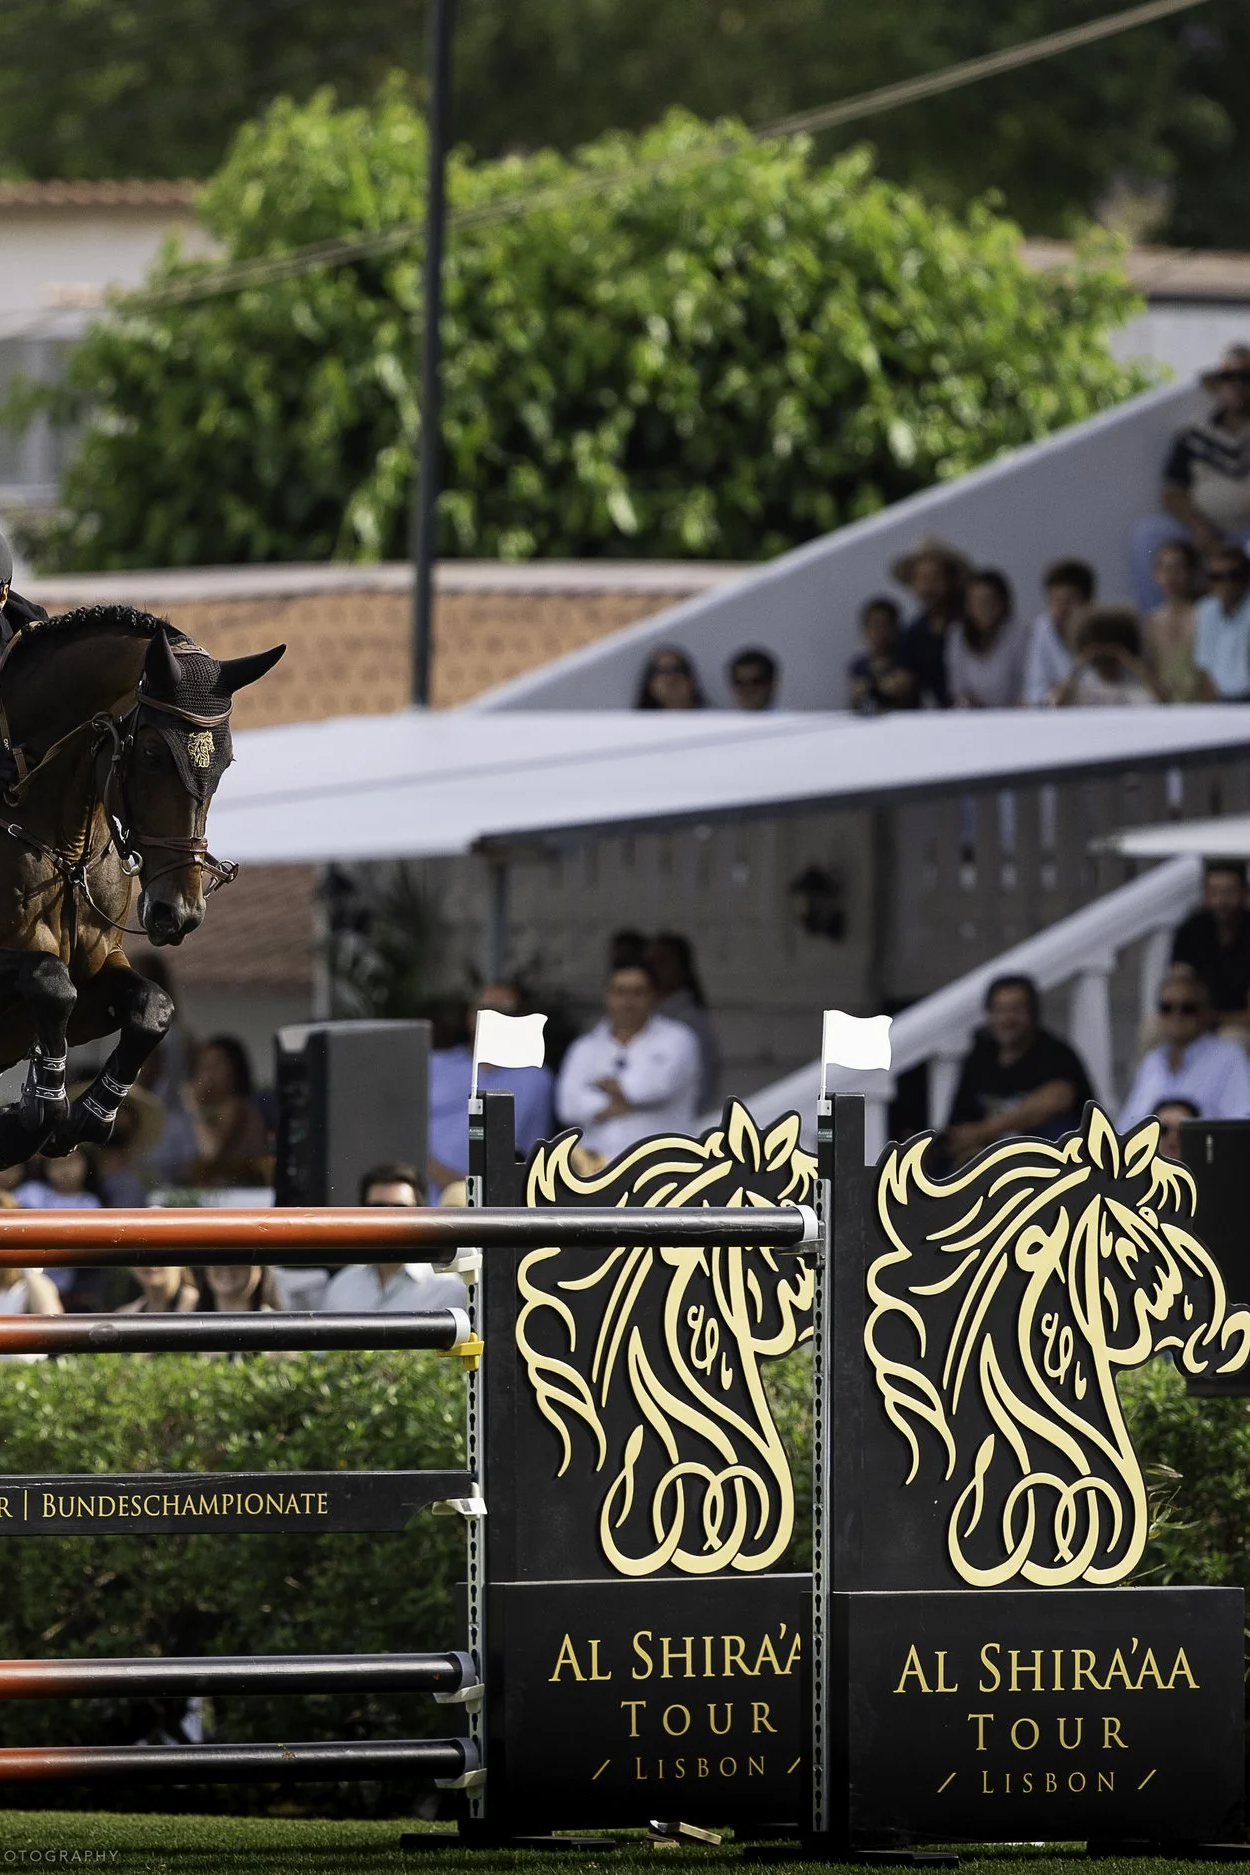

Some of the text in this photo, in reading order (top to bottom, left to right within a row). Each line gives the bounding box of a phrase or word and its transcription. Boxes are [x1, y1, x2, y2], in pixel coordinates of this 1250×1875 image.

[41, 1491, 327, 1518] BUNDESCHAMPIONATE
[549, 1632, 612, 1682] AL
[892, 1637, 1200, 1694] AL SHIRA'AA
[619, 1700, 778, 1737] TOUR
[967, 1713, 1129, 1751] TOUR
[636, 1755, 766, 1781] LISBON
[981, 1769, 1117, 1795] LISBON
